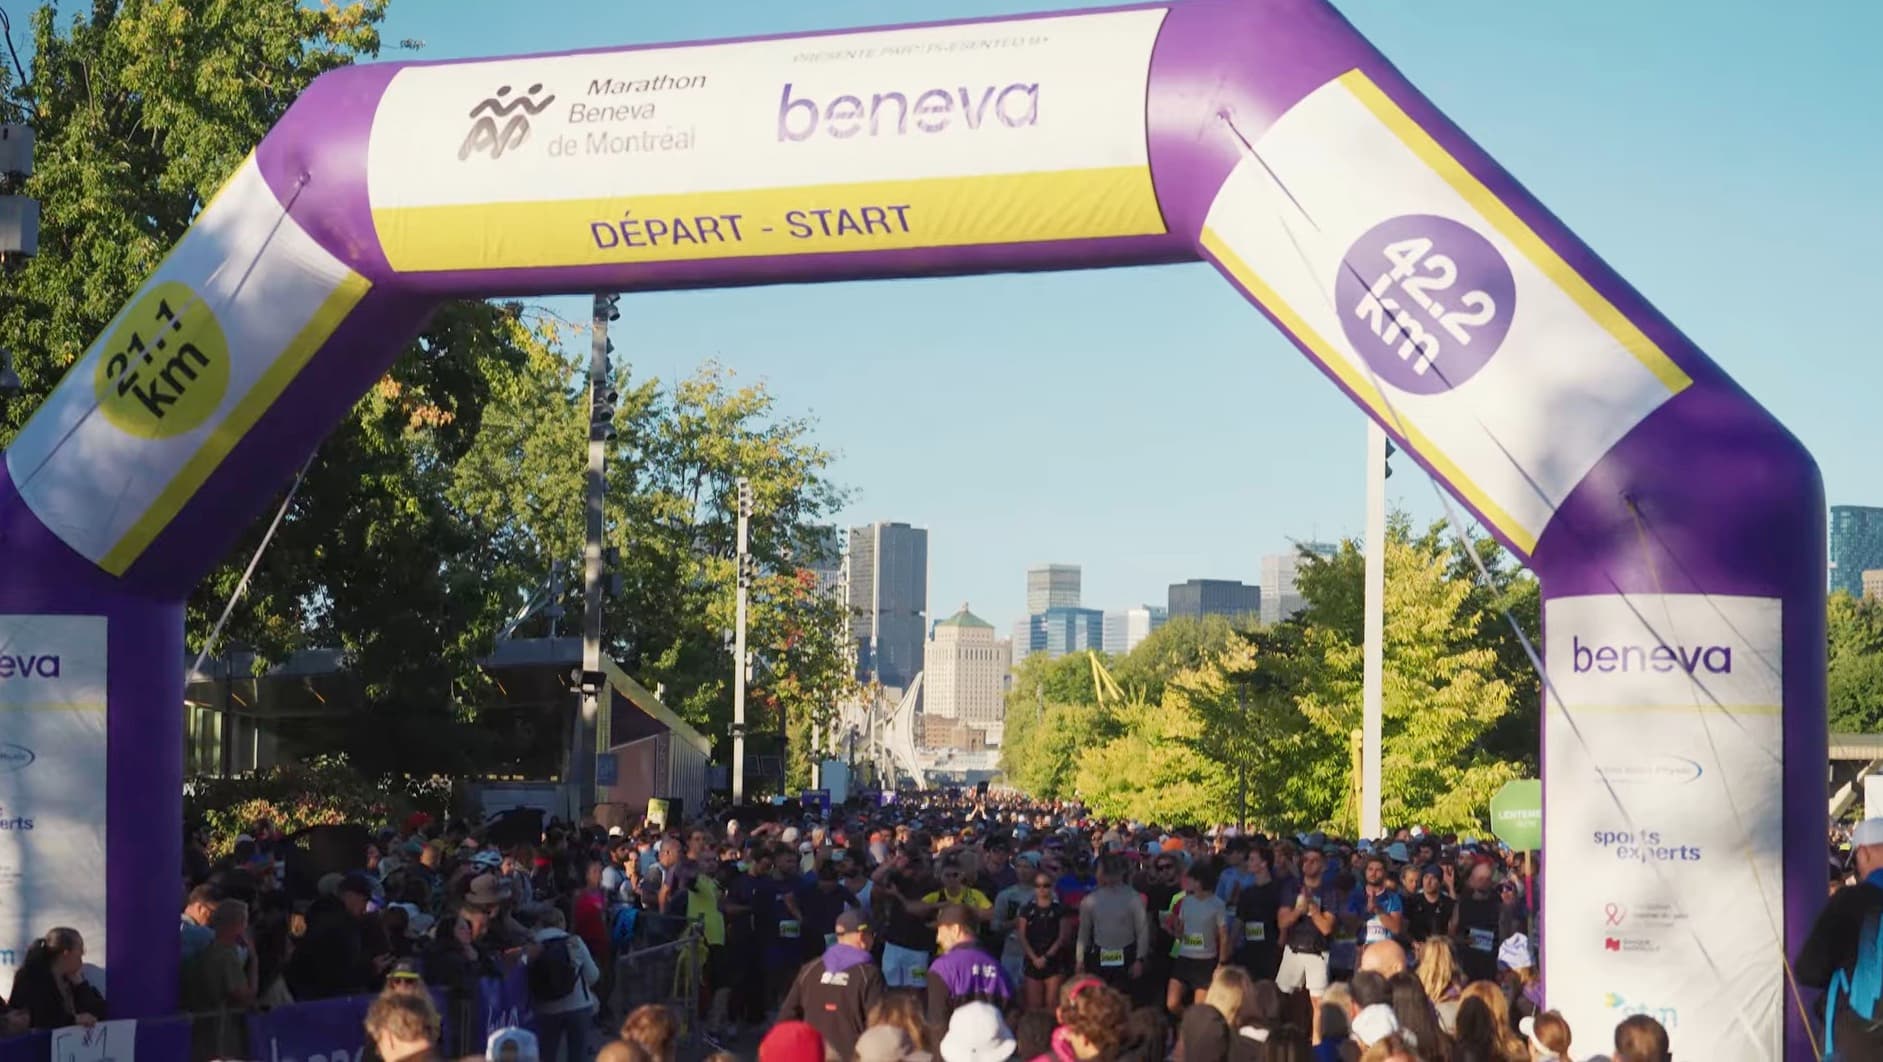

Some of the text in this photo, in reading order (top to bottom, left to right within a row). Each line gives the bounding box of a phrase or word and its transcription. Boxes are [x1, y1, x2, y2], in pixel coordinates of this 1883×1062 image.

[587, 75, 707, 97] Marathon
[568, 102, 656, 124] Beneva
[777, 83, 1040, 142] beneva
[548, 125, 696, 158] de Montréal
[590, 210, 743, 249] DÉPART
[785, 204, 911, 239] START
[1383, 237, 1497, 346] 42.2
[106, 298, 182, 398] 21.1
[1355, 273, 1440, 376] km
[131, 342, 210, 419] km
[1573, 635, 1732, 674] beneva
